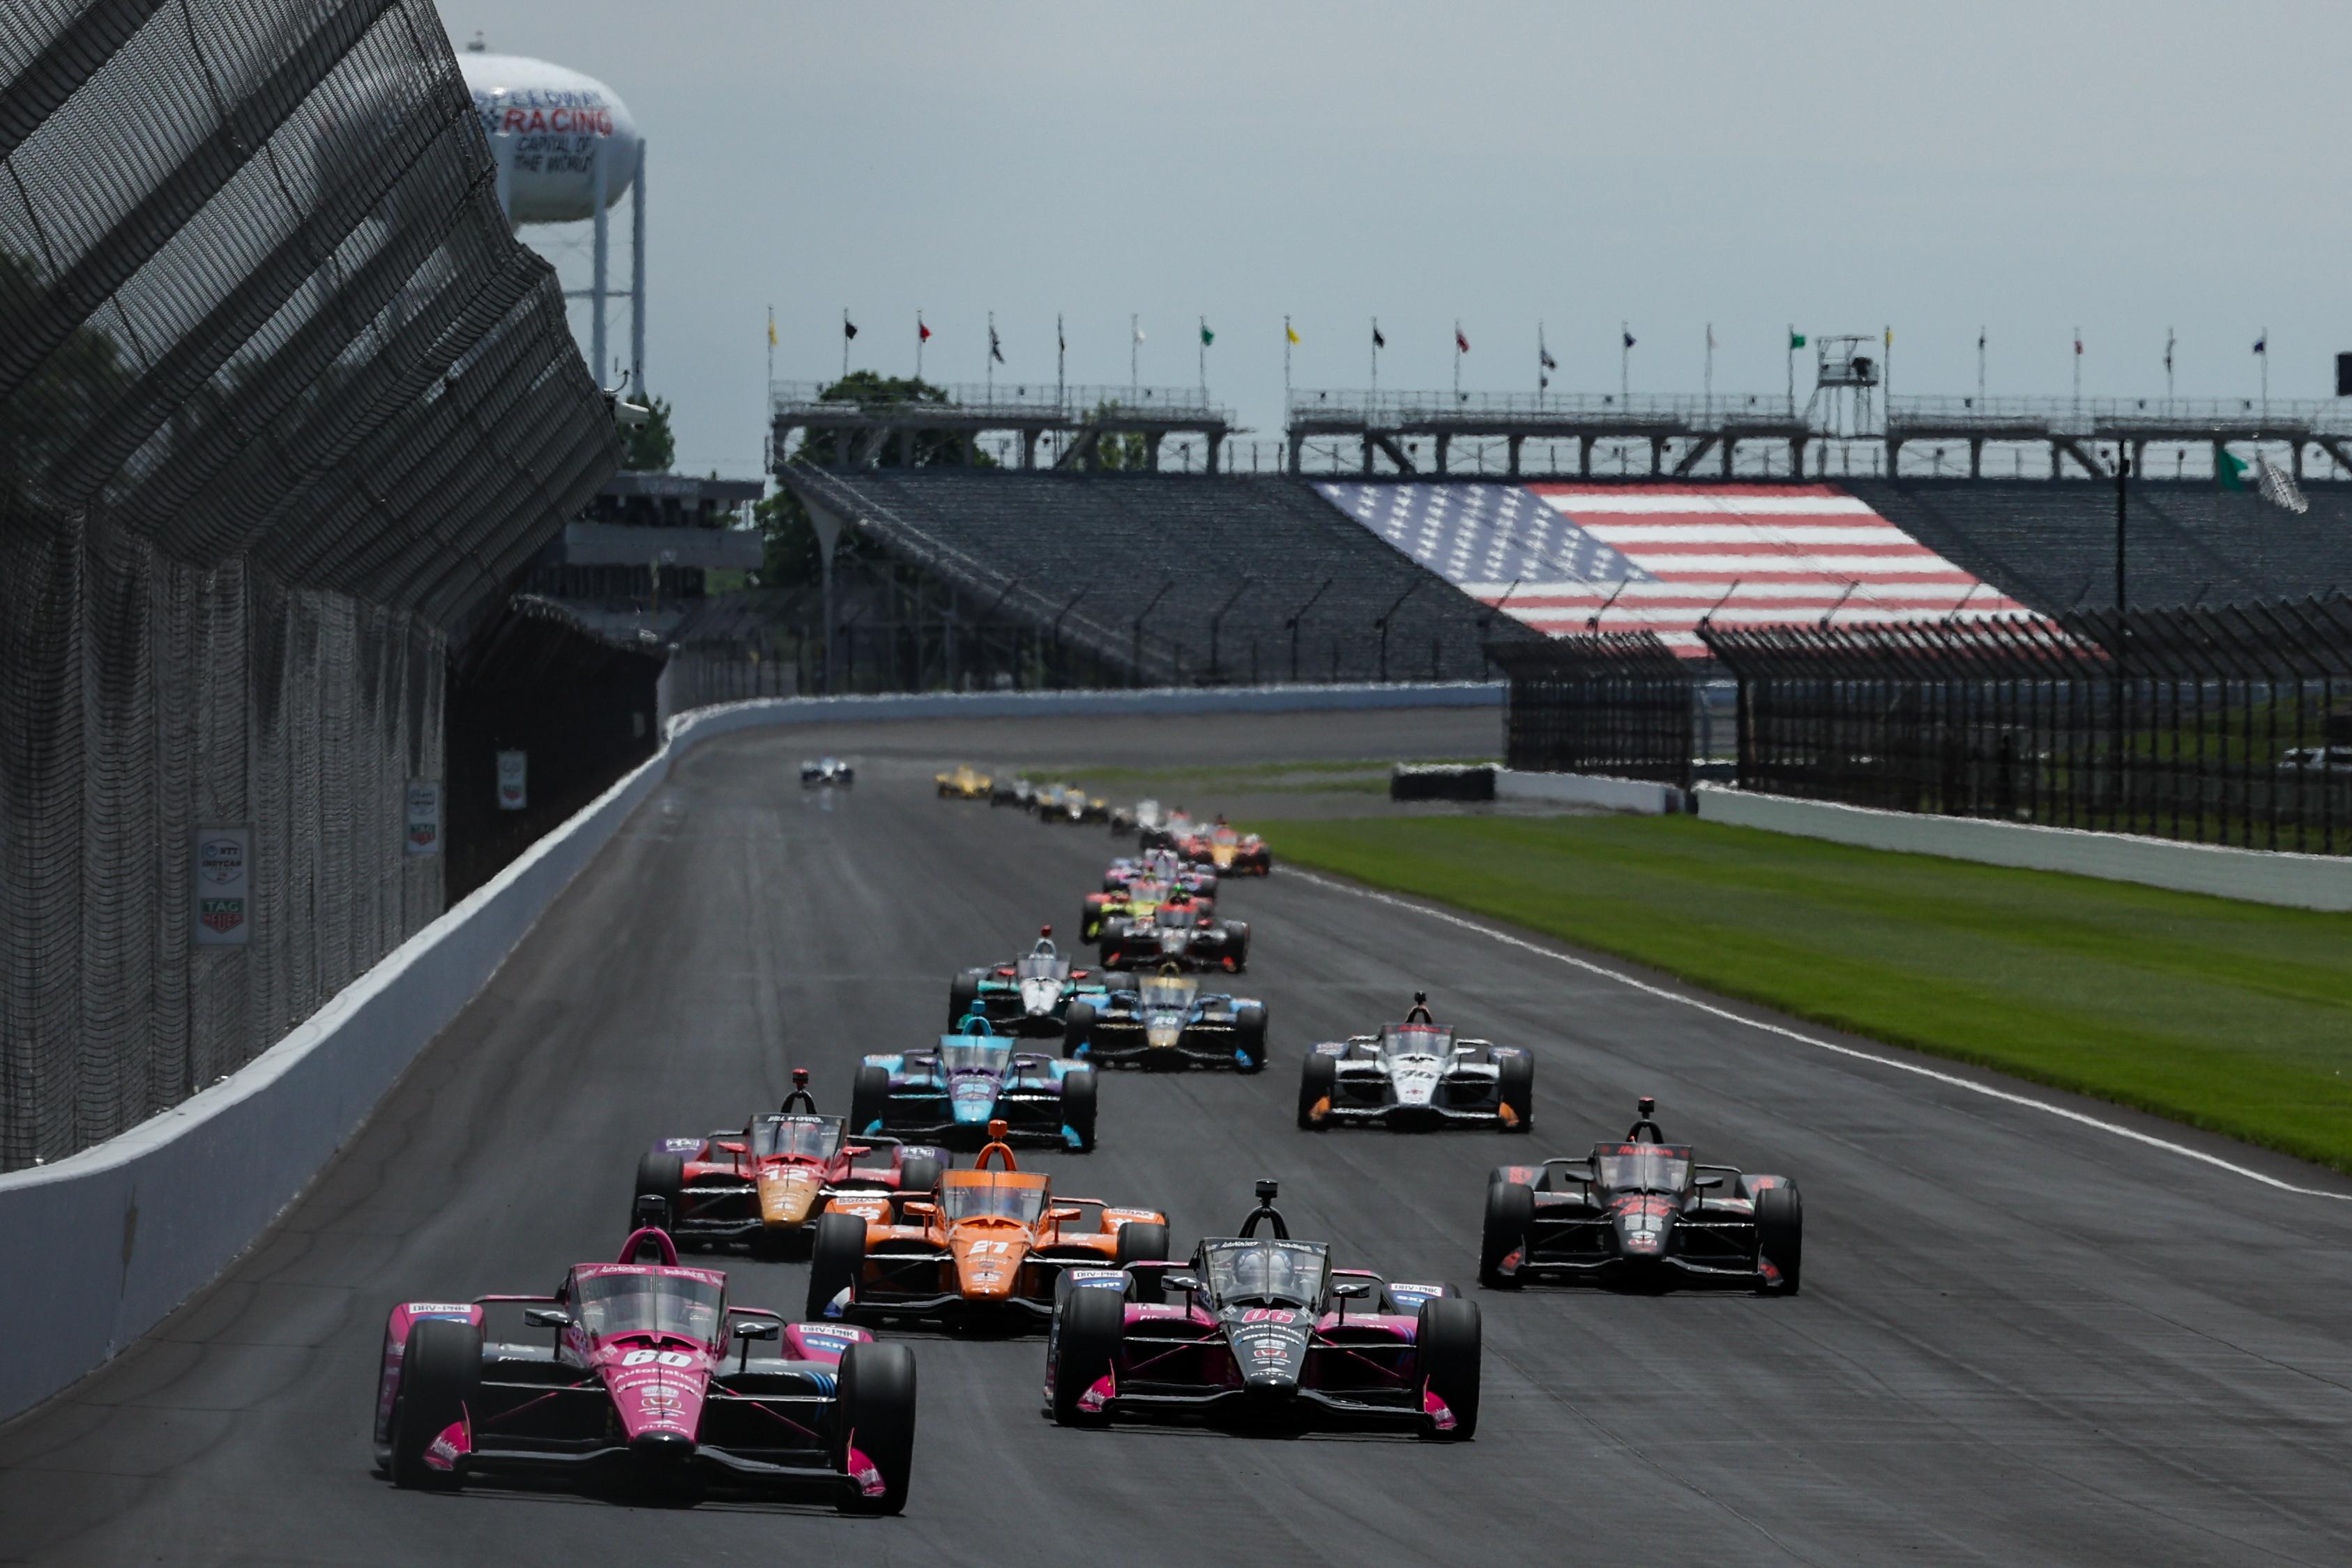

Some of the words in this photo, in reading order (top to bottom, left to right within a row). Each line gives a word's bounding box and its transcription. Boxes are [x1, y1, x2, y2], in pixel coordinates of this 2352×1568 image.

[503, 107, 613, 135] RACING
[517, 136, 570, 152] CAPITAL
[575, 136, 591, 152] OF
[515, 155, 542, 172] THE
[206, 901, 239, 912] TAG
[764, 1170, 809, 1183] 12
[969, 1240, 1010, 1254] 21
[1241, 1308, 1296, 1324] 06
[1232, 1324, 1305, 1341] AutoNation
[621, 1349, 692, 1368] 60
[614, 1368, 702, 1390] AutoNation
